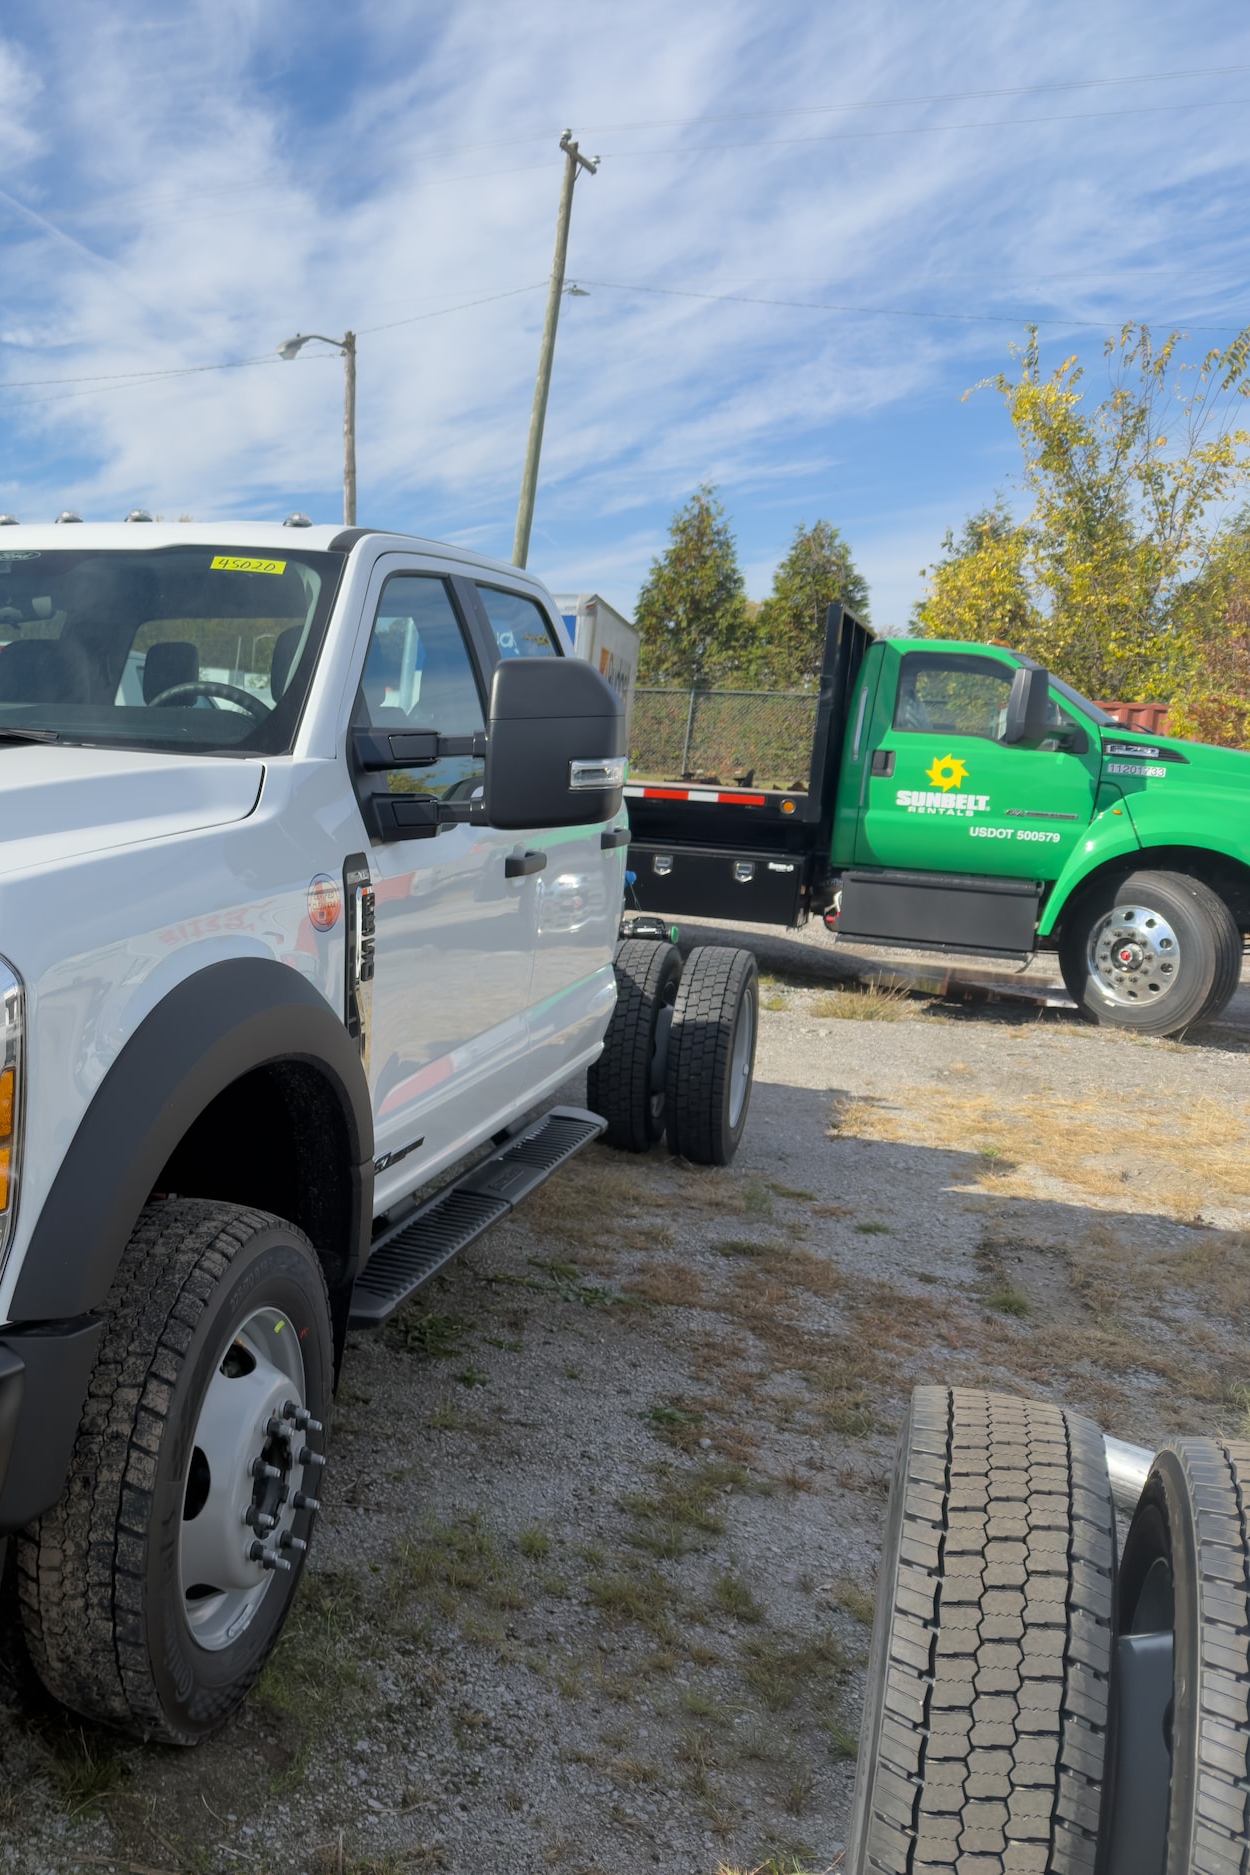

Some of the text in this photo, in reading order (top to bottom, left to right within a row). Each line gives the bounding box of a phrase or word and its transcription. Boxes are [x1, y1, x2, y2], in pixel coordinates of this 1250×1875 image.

[217, 557, 277, 572] 45020
[1109, 764, 1166, 778] 11201733
[895, 790, 990, 812] SUNBELT
[907, 806, 975, 817] RENTALS
[969, 826, 1061, 844] USDOT 500579
